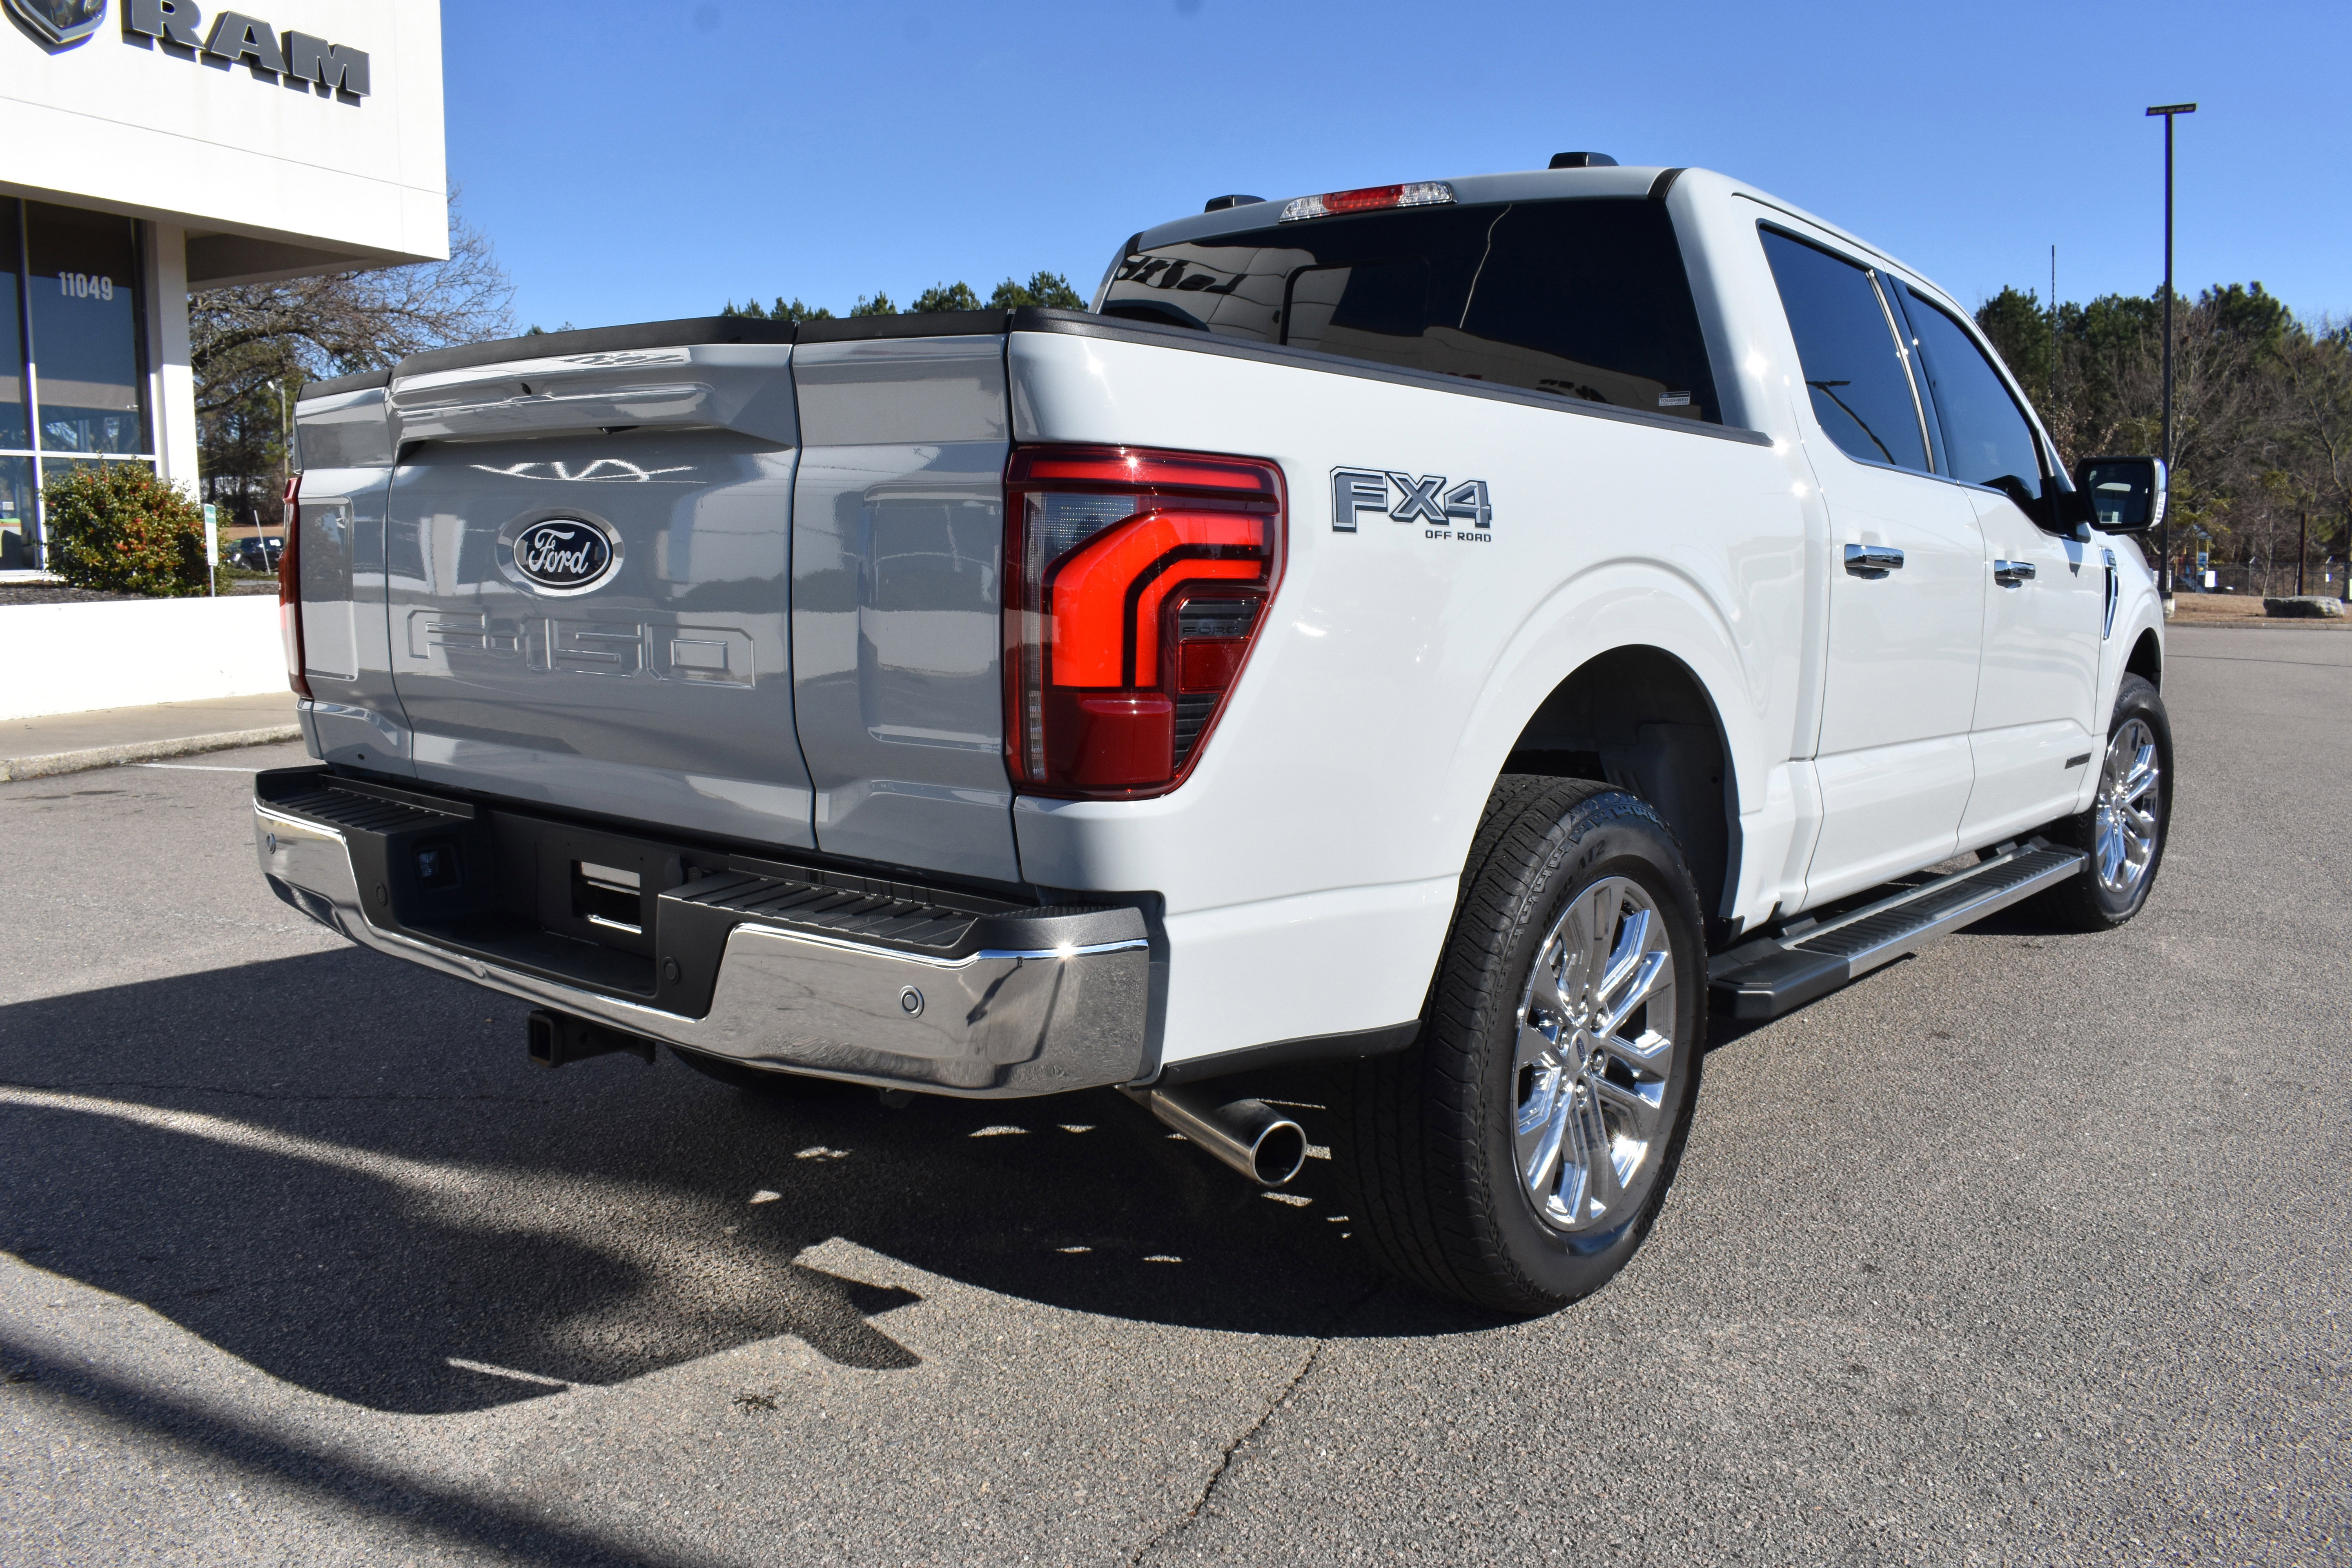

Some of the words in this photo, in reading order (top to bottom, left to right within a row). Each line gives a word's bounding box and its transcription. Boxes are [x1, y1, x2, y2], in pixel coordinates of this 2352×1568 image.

[121, 0, 371, 97] RAM
[59, 272, 113, 301] 11049
[1330, 466, 1492, 533] FX4
[529, 529, 591, 574] Ford
[1425, 530, 1452, 540] OFF
[1457, 532, 1492, 542] ROAD
[408, 609, 755, 690] F-150
